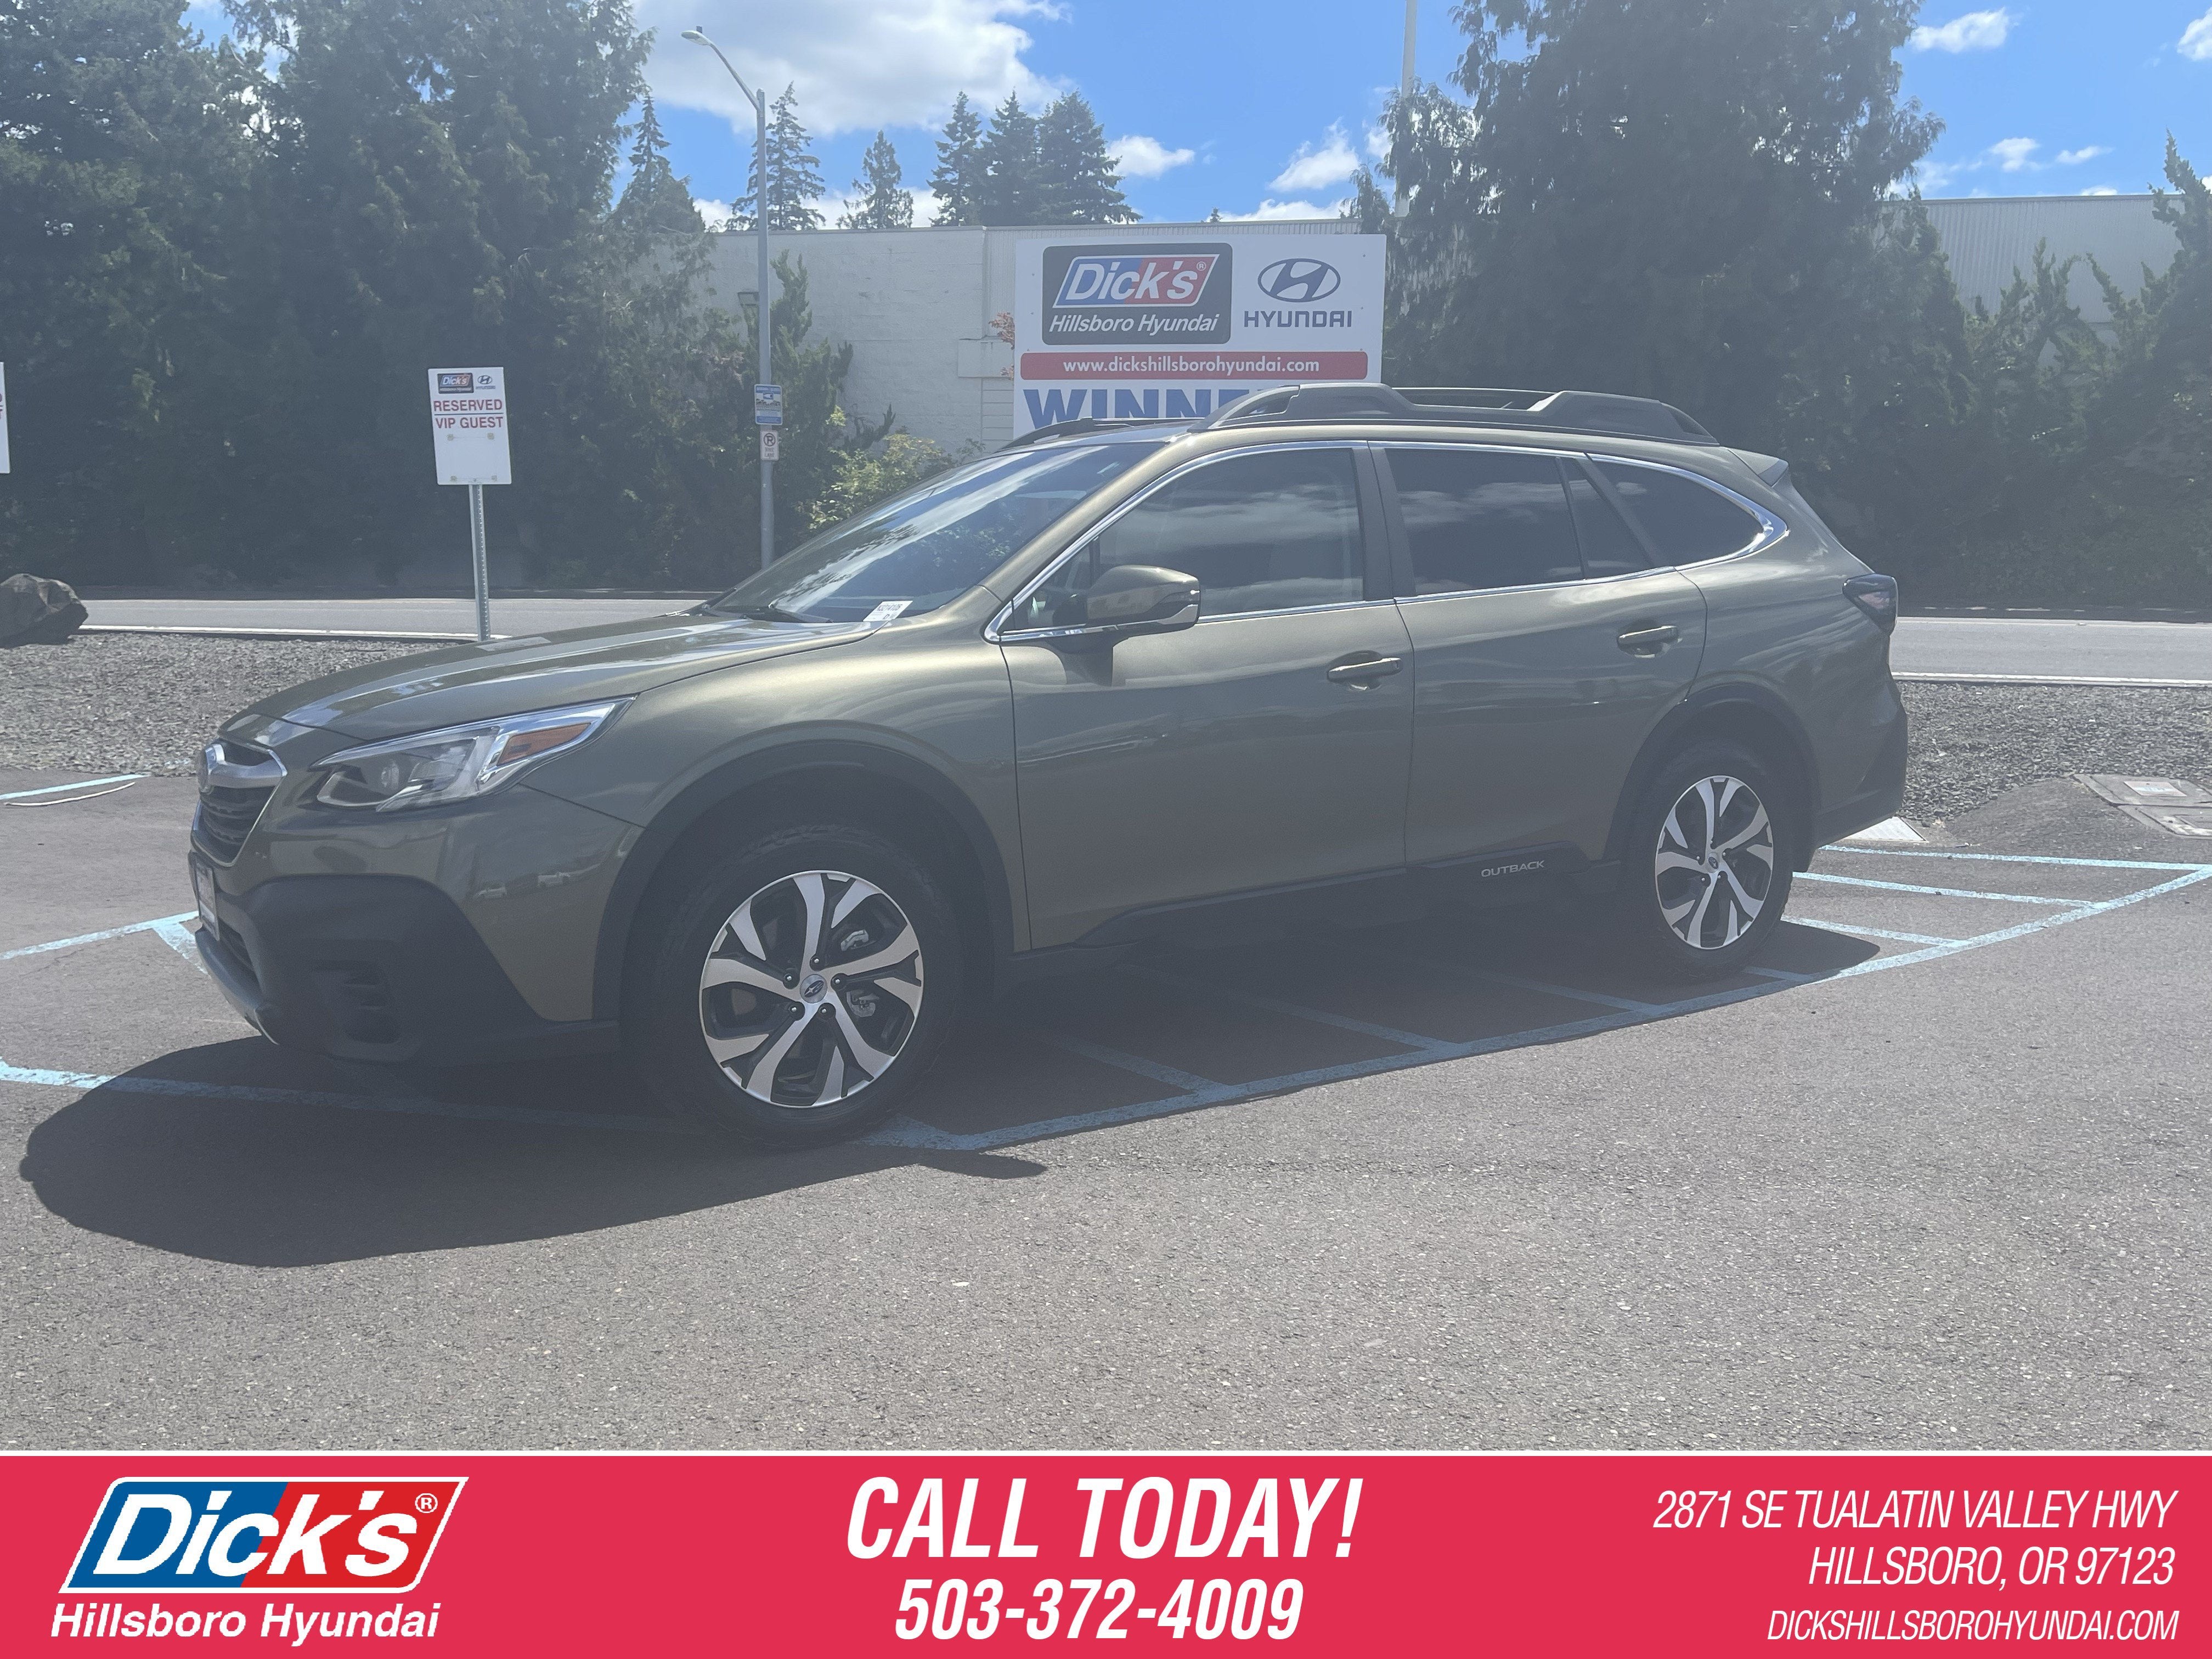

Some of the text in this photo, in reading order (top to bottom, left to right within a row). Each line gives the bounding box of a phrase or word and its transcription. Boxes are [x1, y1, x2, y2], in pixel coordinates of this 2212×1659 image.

[1065, 261, 1198, 300] Dick's
[1049, 313, 1219, 335] Hillsboro Hyundai
[1244, 310, 1353, 328] HYUNDAI
[1063, 356, 1321, 376] www.dickshillsborohyundai.com
[433, 399, 503, 411] RESERVED
[436, 416, 504, 428] VIP GUEST
[1481, 860, 1545, 878] OUTBACK
